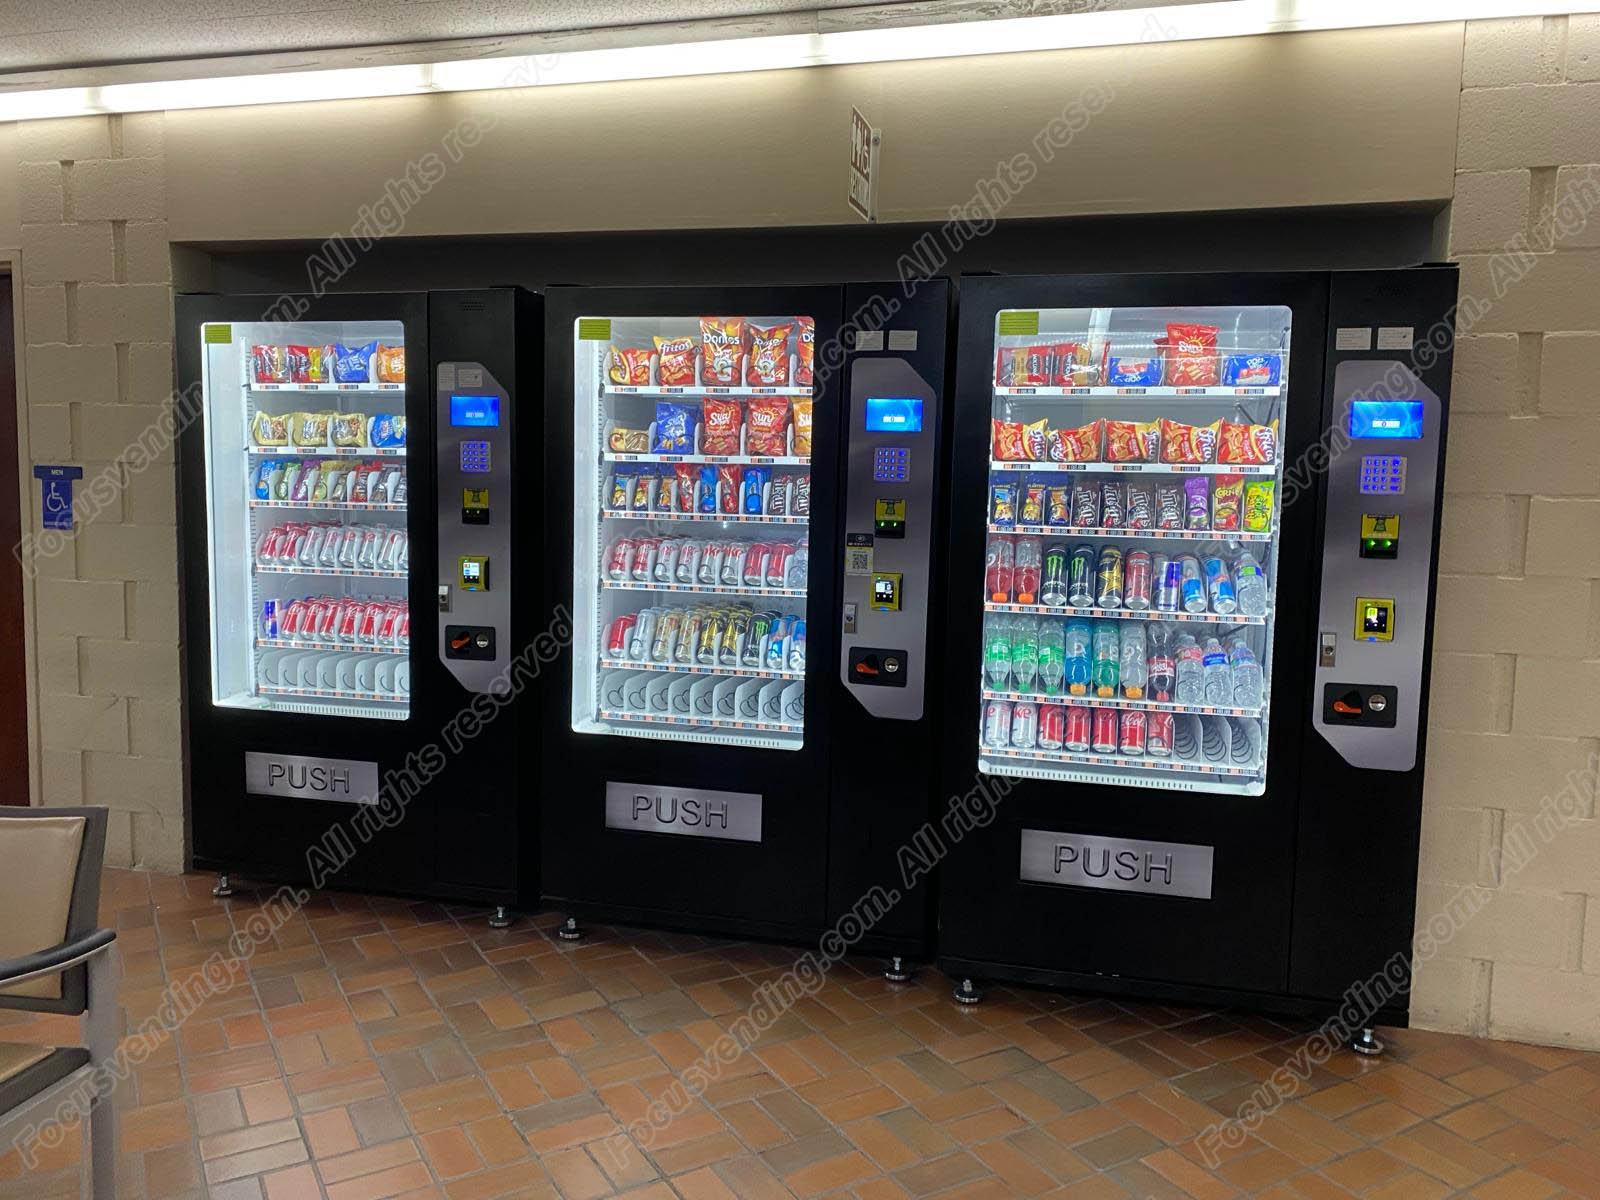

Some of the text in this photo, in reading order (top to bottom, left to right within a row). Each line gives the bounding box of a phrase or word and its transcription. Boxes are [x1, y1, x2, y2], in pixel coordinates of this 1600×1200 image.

[268, 762, 350, 794] PUSH
[632, 793, 728, 829] PUSH
[1054, 843, 1173, 886] PUSH
